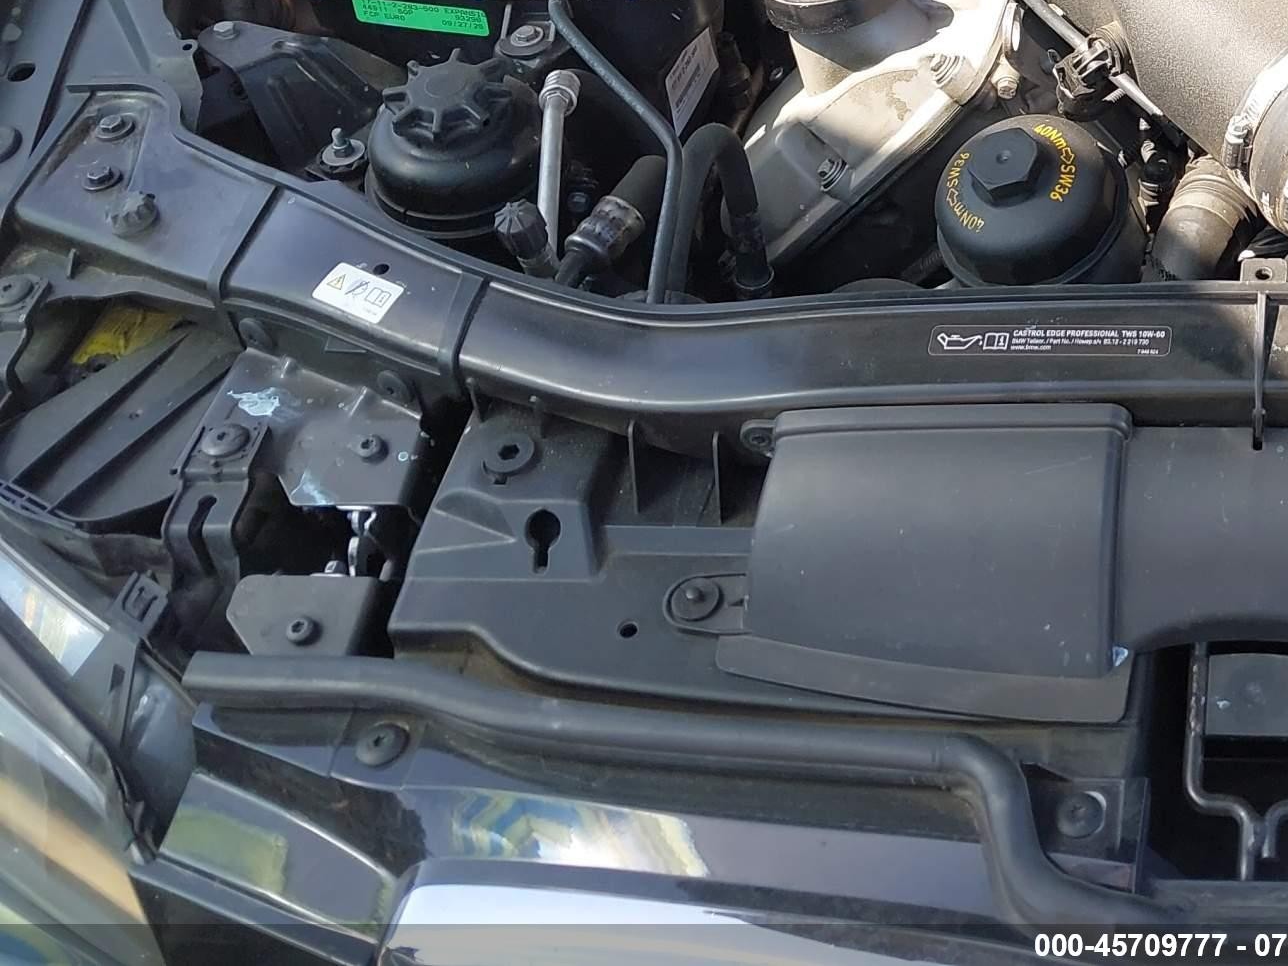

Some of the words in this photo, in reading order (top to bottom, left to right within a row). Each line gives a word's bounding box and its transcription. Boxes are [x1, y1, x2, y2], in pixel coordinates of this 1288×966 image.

[384, 12, 406, 21] EURO
[1032, 123, 1067, 149] 40Nm
[946, 152, 970, 188] SW36
[1049, 164, 1077, 202] SW36
[954, 202, 985, 233] 40Nm
[1013, 329, 1046, 337] CASTROL
[1046, 329, 1066, 337] EDGE
[1066, 329, 1119, 338] PROFESSIONAL
[1121, 330, 1137, 338] TWS
